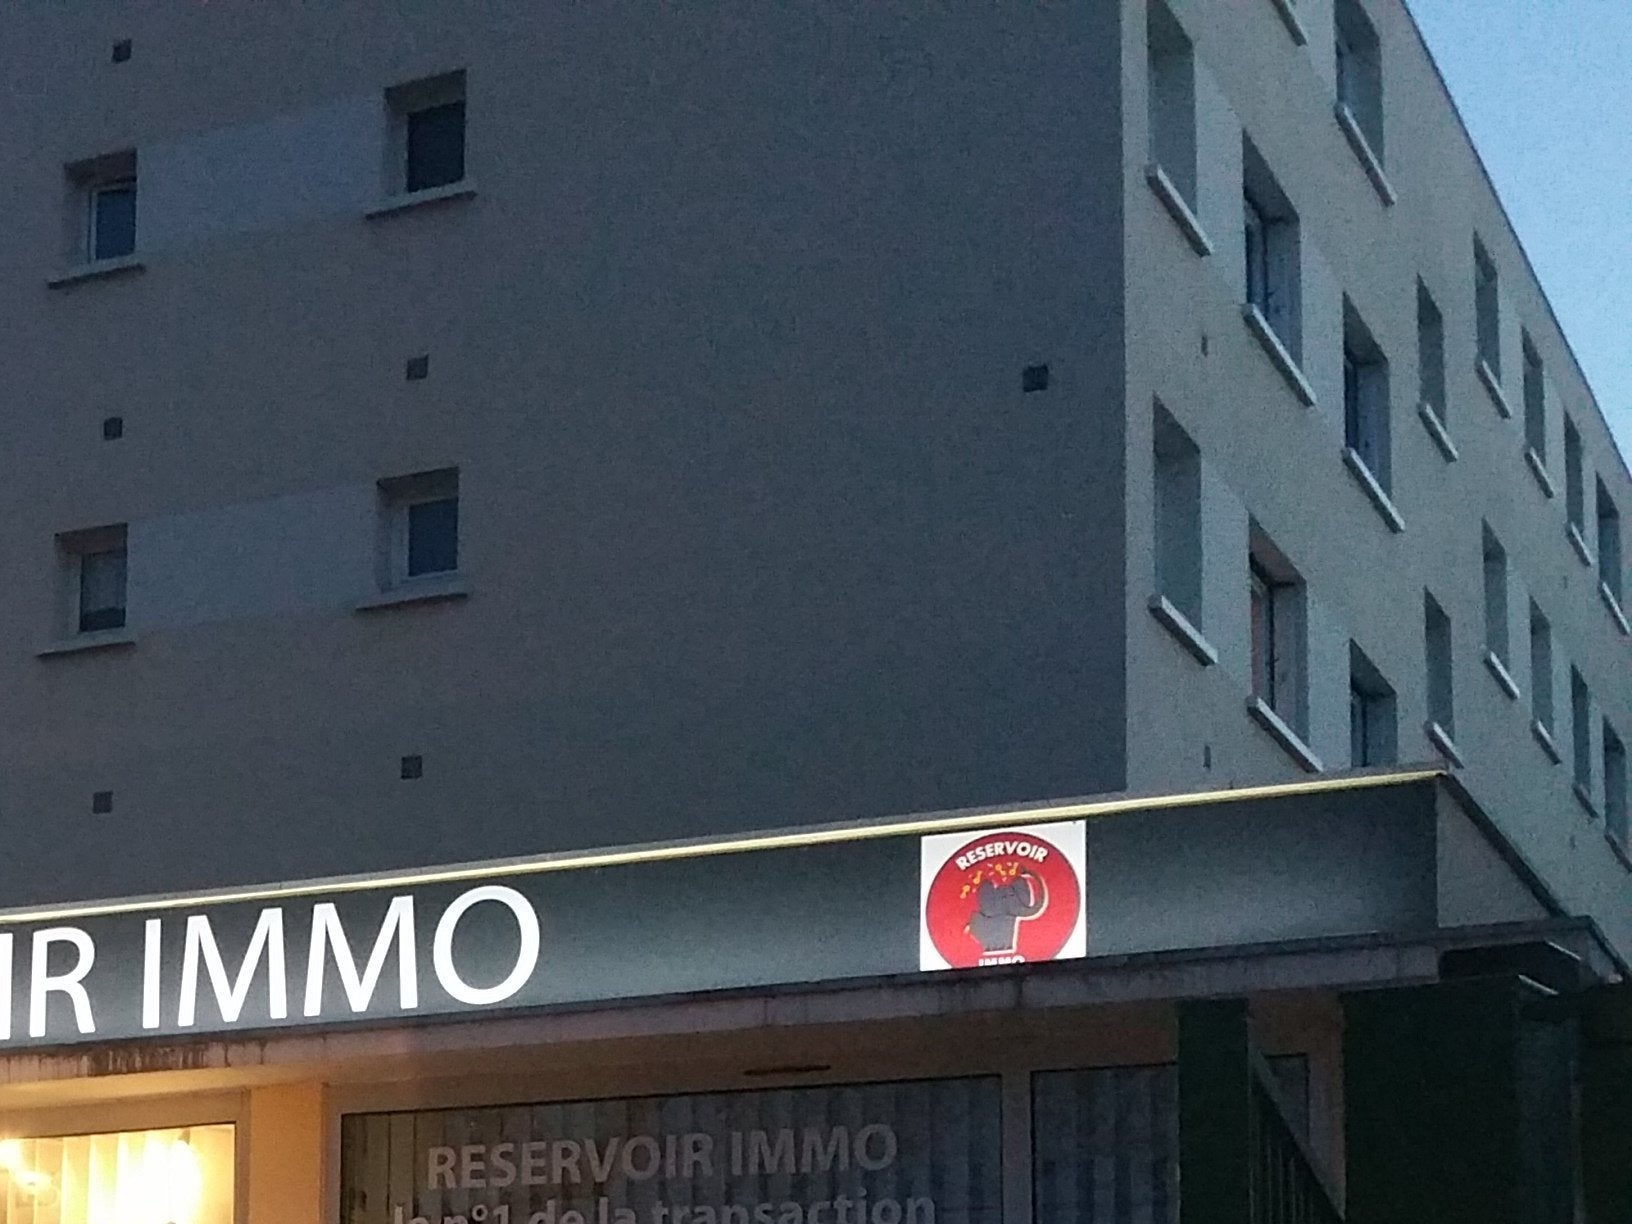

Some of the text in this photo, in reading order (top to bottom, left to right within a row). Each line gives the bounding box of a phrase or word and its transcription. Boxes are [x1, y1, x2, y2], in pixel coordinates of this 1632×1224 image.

[955, 840, 1049, 871] RESERVOIR
[141, 884, 543, 1031] IMMO
[428, 1123, 899, 1191] RESERVOIR IMMO
